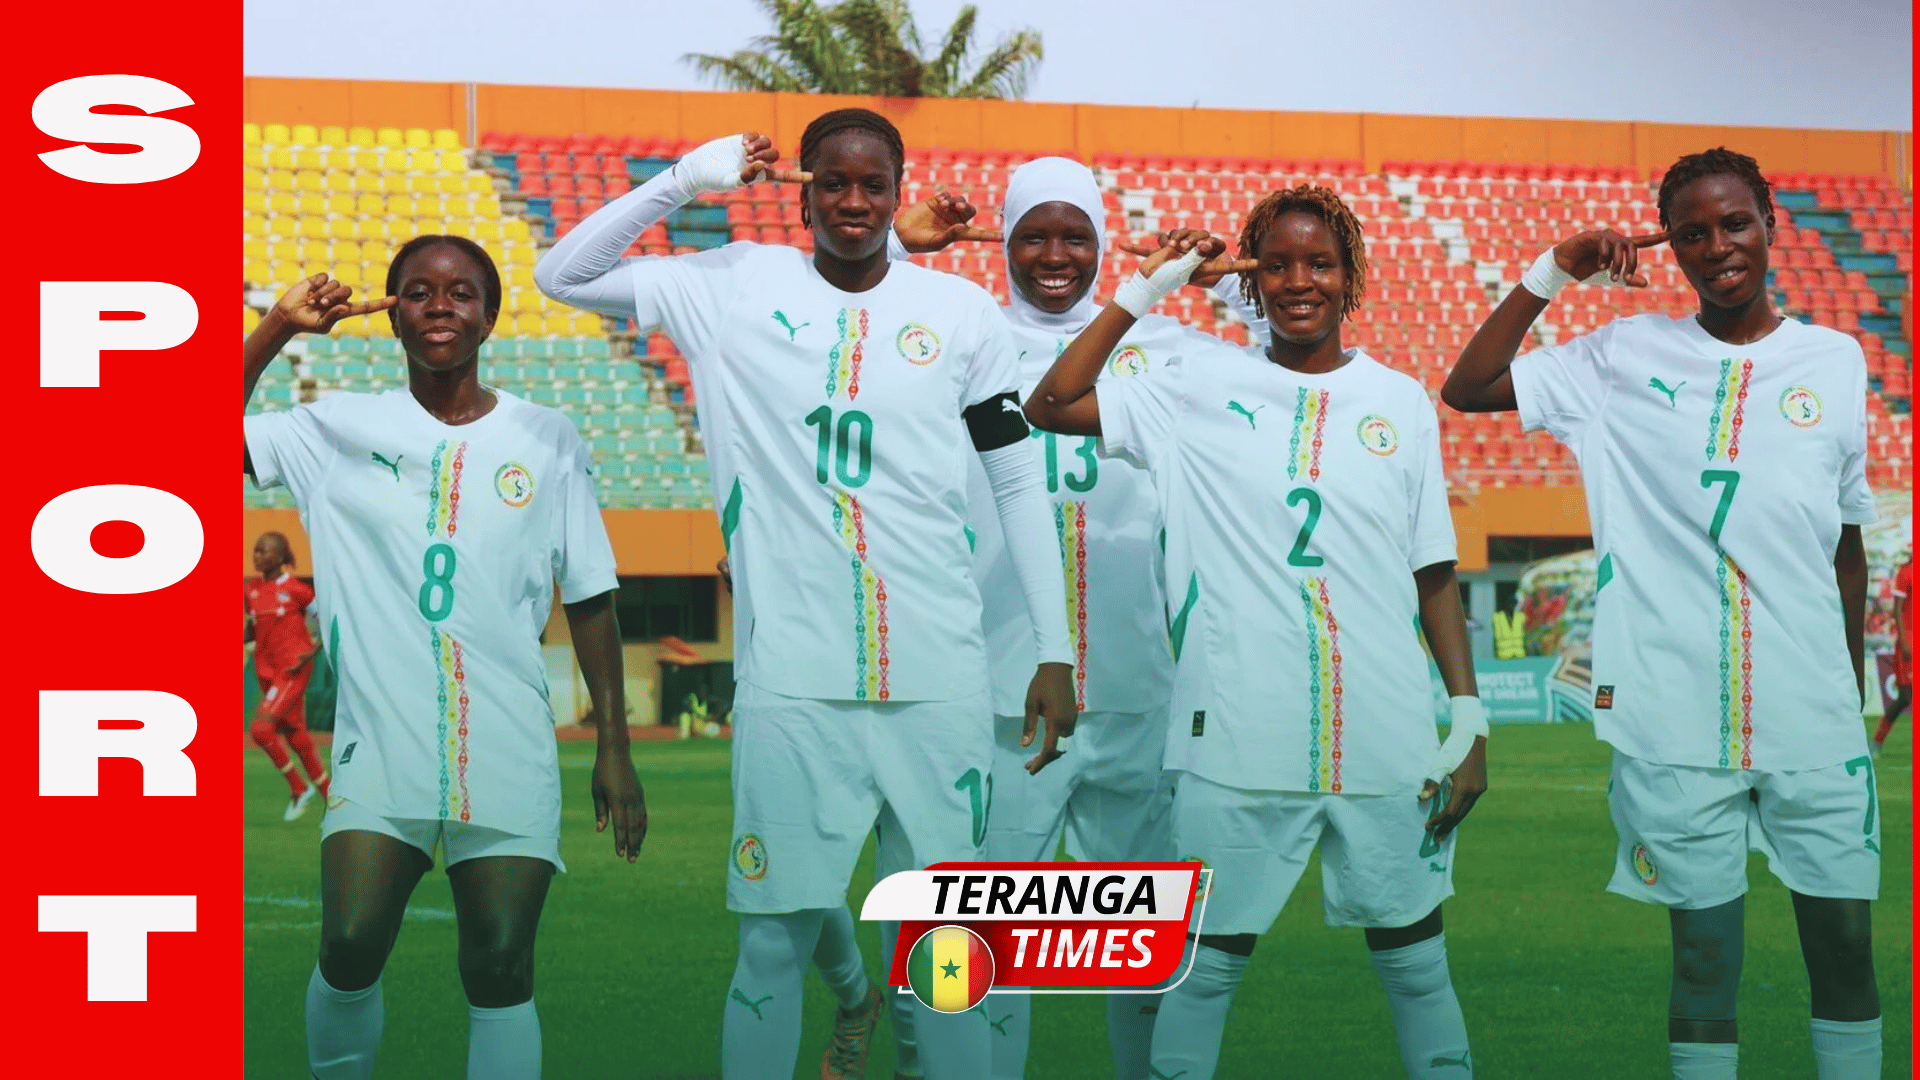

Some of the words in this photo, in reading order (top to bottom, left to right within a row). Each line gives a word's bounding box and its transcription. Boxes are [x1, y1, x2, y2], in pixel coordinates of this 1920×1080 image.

[804, 404, 873, 489] 10
[1030, 427, 1098, 493] 13
[1286, 486, 1325, 567] 2
[1701, 469, 1740, 545] 7
[418, 543, 457, 622] 8
[1844, 755, 1876, 836] 7
